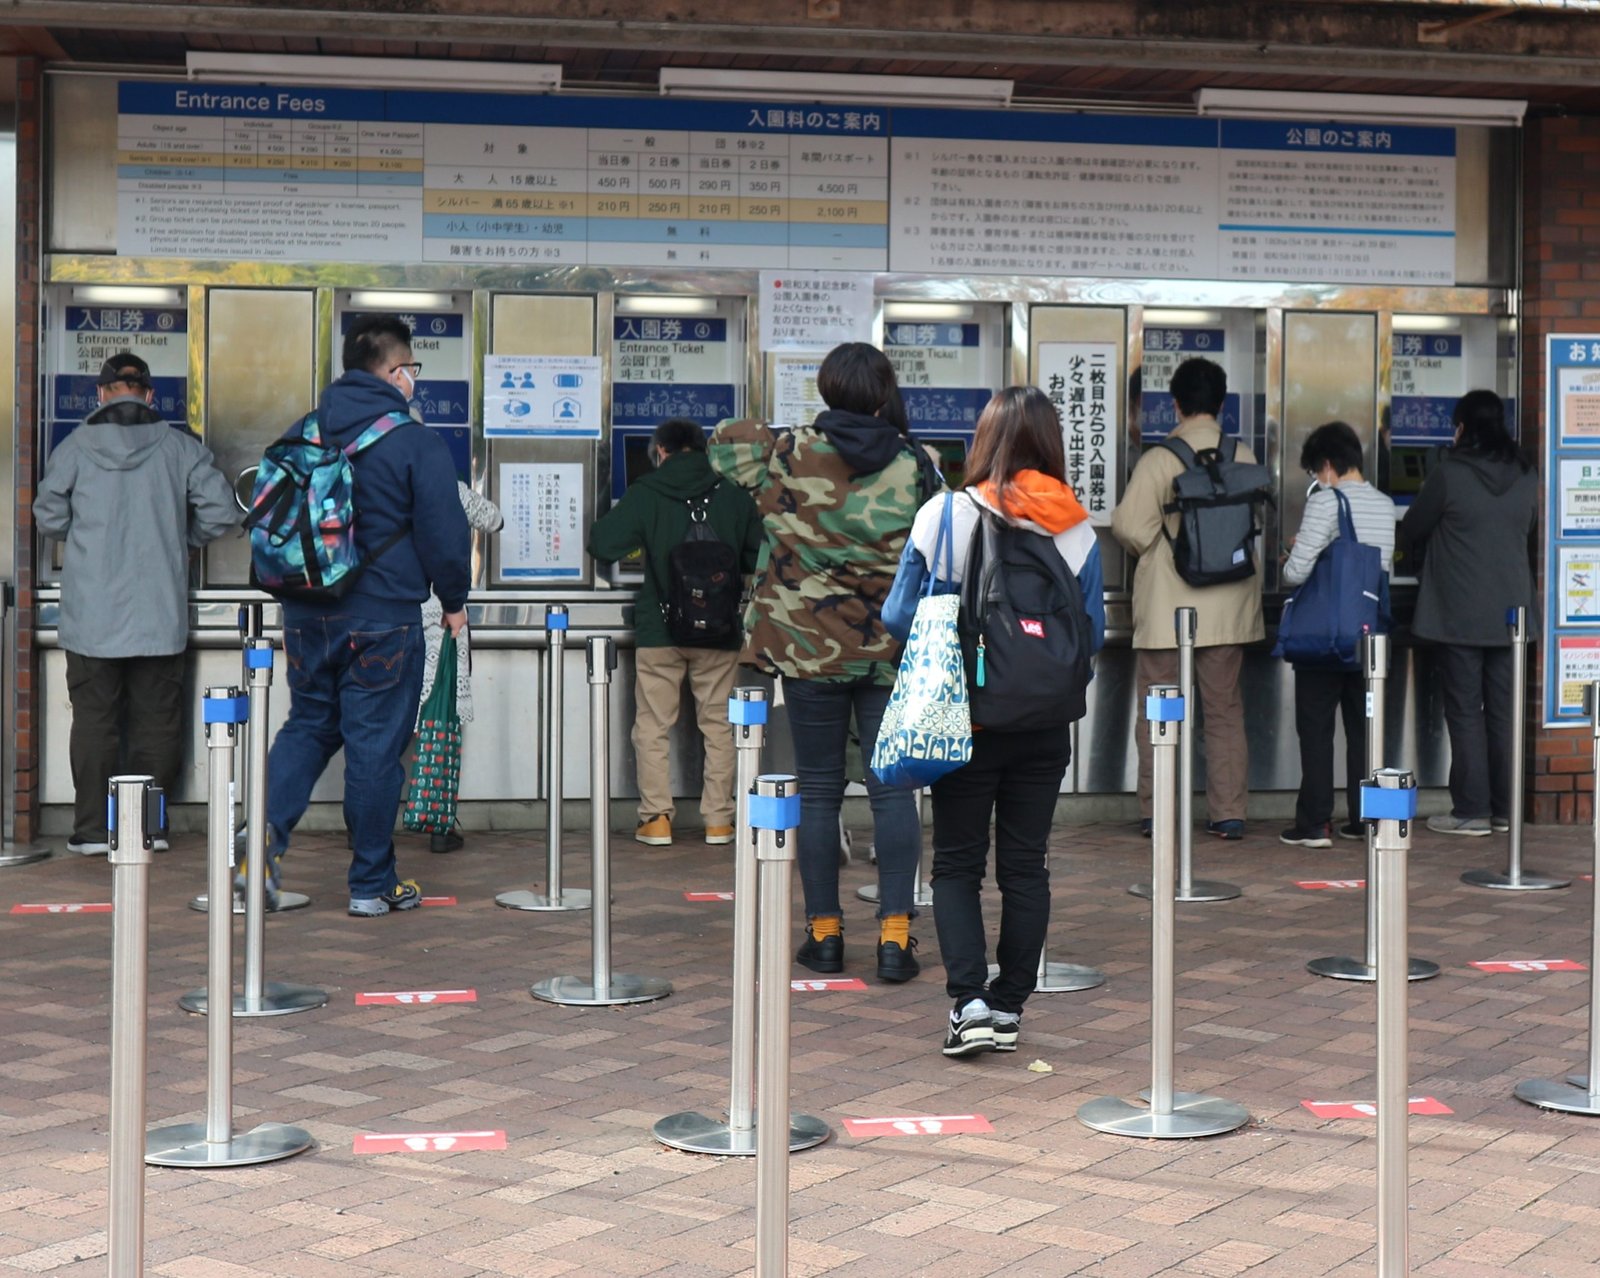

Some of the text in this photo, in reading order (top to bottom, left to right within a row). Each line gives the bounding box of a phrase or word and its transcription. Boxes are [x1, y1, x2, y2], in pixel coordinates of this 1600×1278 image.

[175, 91, 326, 112] Entrance Fees
[747, 109, 881, 130] 入園料のご案内
[1286, 127, 1392, 148] 公園のご案内
[598, 154, 630, 167] 当日券
[699, 157, 731, 169] 当日券
[800, 151, 875, 164] 年間パスポート
[437, 197, 480, 207] シルバー
[450, 245, 539, 257] 障害をお持ちの方
[773, 291, 831, 302] 公園入園券の
[77, 309, 145, 331] 入園券
[619, 319, 683, 340] 入園券
[772, 327, 811, 338] おります。
[76, 332, 168, 346] Entrance Ticket
[411, 338, 440, 351] icket
[619, 343, 705, 354] Entrance Ticket
[620, 355, 671, 367] 公园门票
[1413, 358, 1442, 368] Ticket
[620, 369, 645, 381] 파크
[645, 390, 698, 403] ようこそ
[1398, 403, 1446, 416] ようこそ
[1089, 354, 1106, 512] 二枚目からの入園券は
[569, 497, 577, 529] お知らせ
[1022, 620, 1042, 636] Lee
